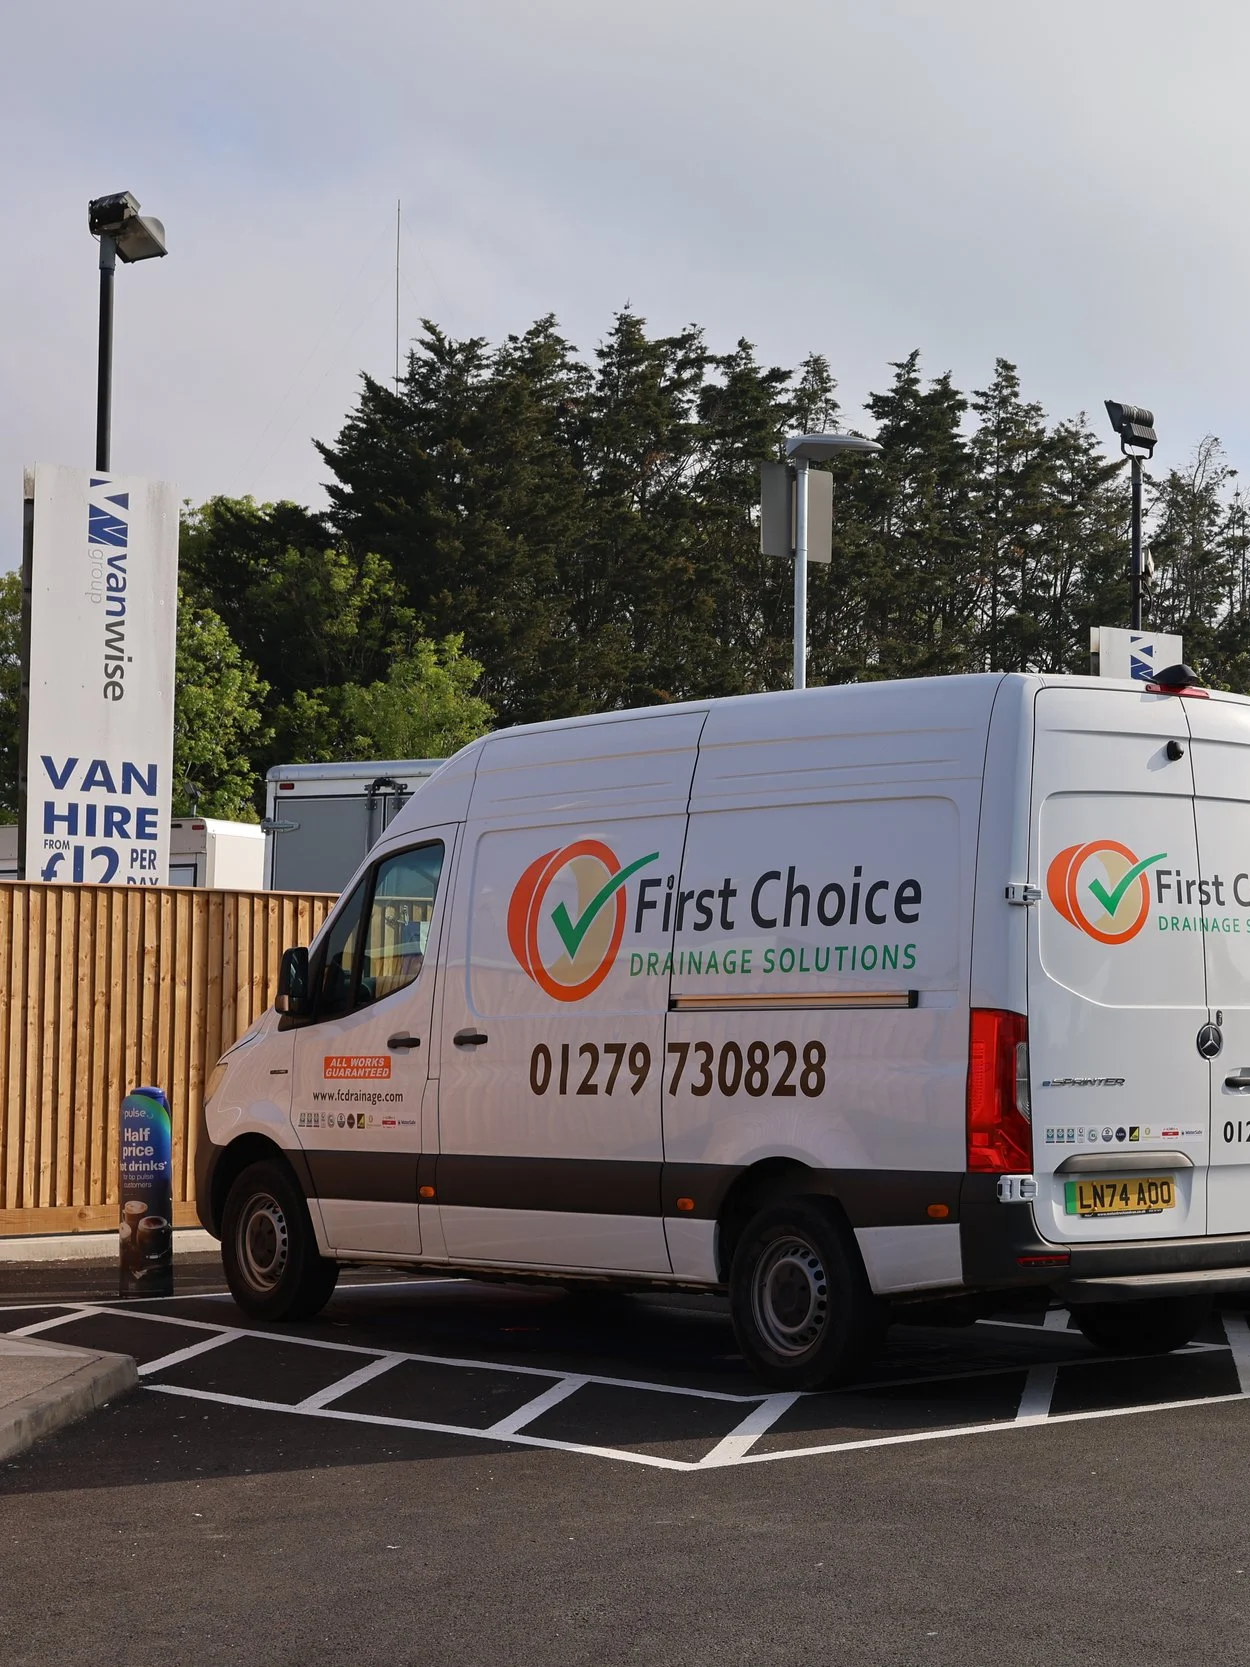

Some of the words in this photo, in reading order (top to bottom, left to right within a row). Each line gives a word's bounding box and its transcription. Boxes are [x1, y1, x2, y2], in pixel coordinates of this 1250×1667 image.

[84, 548, 104, 605] group
[103, 553, 133, 702] vanwise
[40, 755, 158, 797] VAN
[43, 800, 159, 841] HIRE
[43, 839, 70, 850] FROM
[130, 848, 157, 870] PER
[1155, 869, 1225, 907] First
[634, 874, 738, 933] First
[750, 865, 922, 929] Choice
[1158, 916, 1240, 933] DRAINAGE
[630, 949, 752, 976] DRAINAGE
[763, 943, 917, 974] SOLUTIONS
[330, 1058, 347, 1067] ALL
[350, 1058, 385, 1067] WORKS
[529, 1042, 652, 1097] 01279
[667, 1040, 827, 1098] 730828
[325, 1068, 389, 1077] GUARANTEED
[312, 1089, 404, 1105] www.fcdrainage.com
[124, 1107, 147, 1120] pulse
[124, 1127, 151, 1142] Half
[122, 1143, 154, 1160] price
[123, 1181, 152, 1189] customers
[128, 1174, 136, 1182] bp
[136, 1173, 154, 1182] pulse
[1079, 1183, 1131, 1209] LN74
